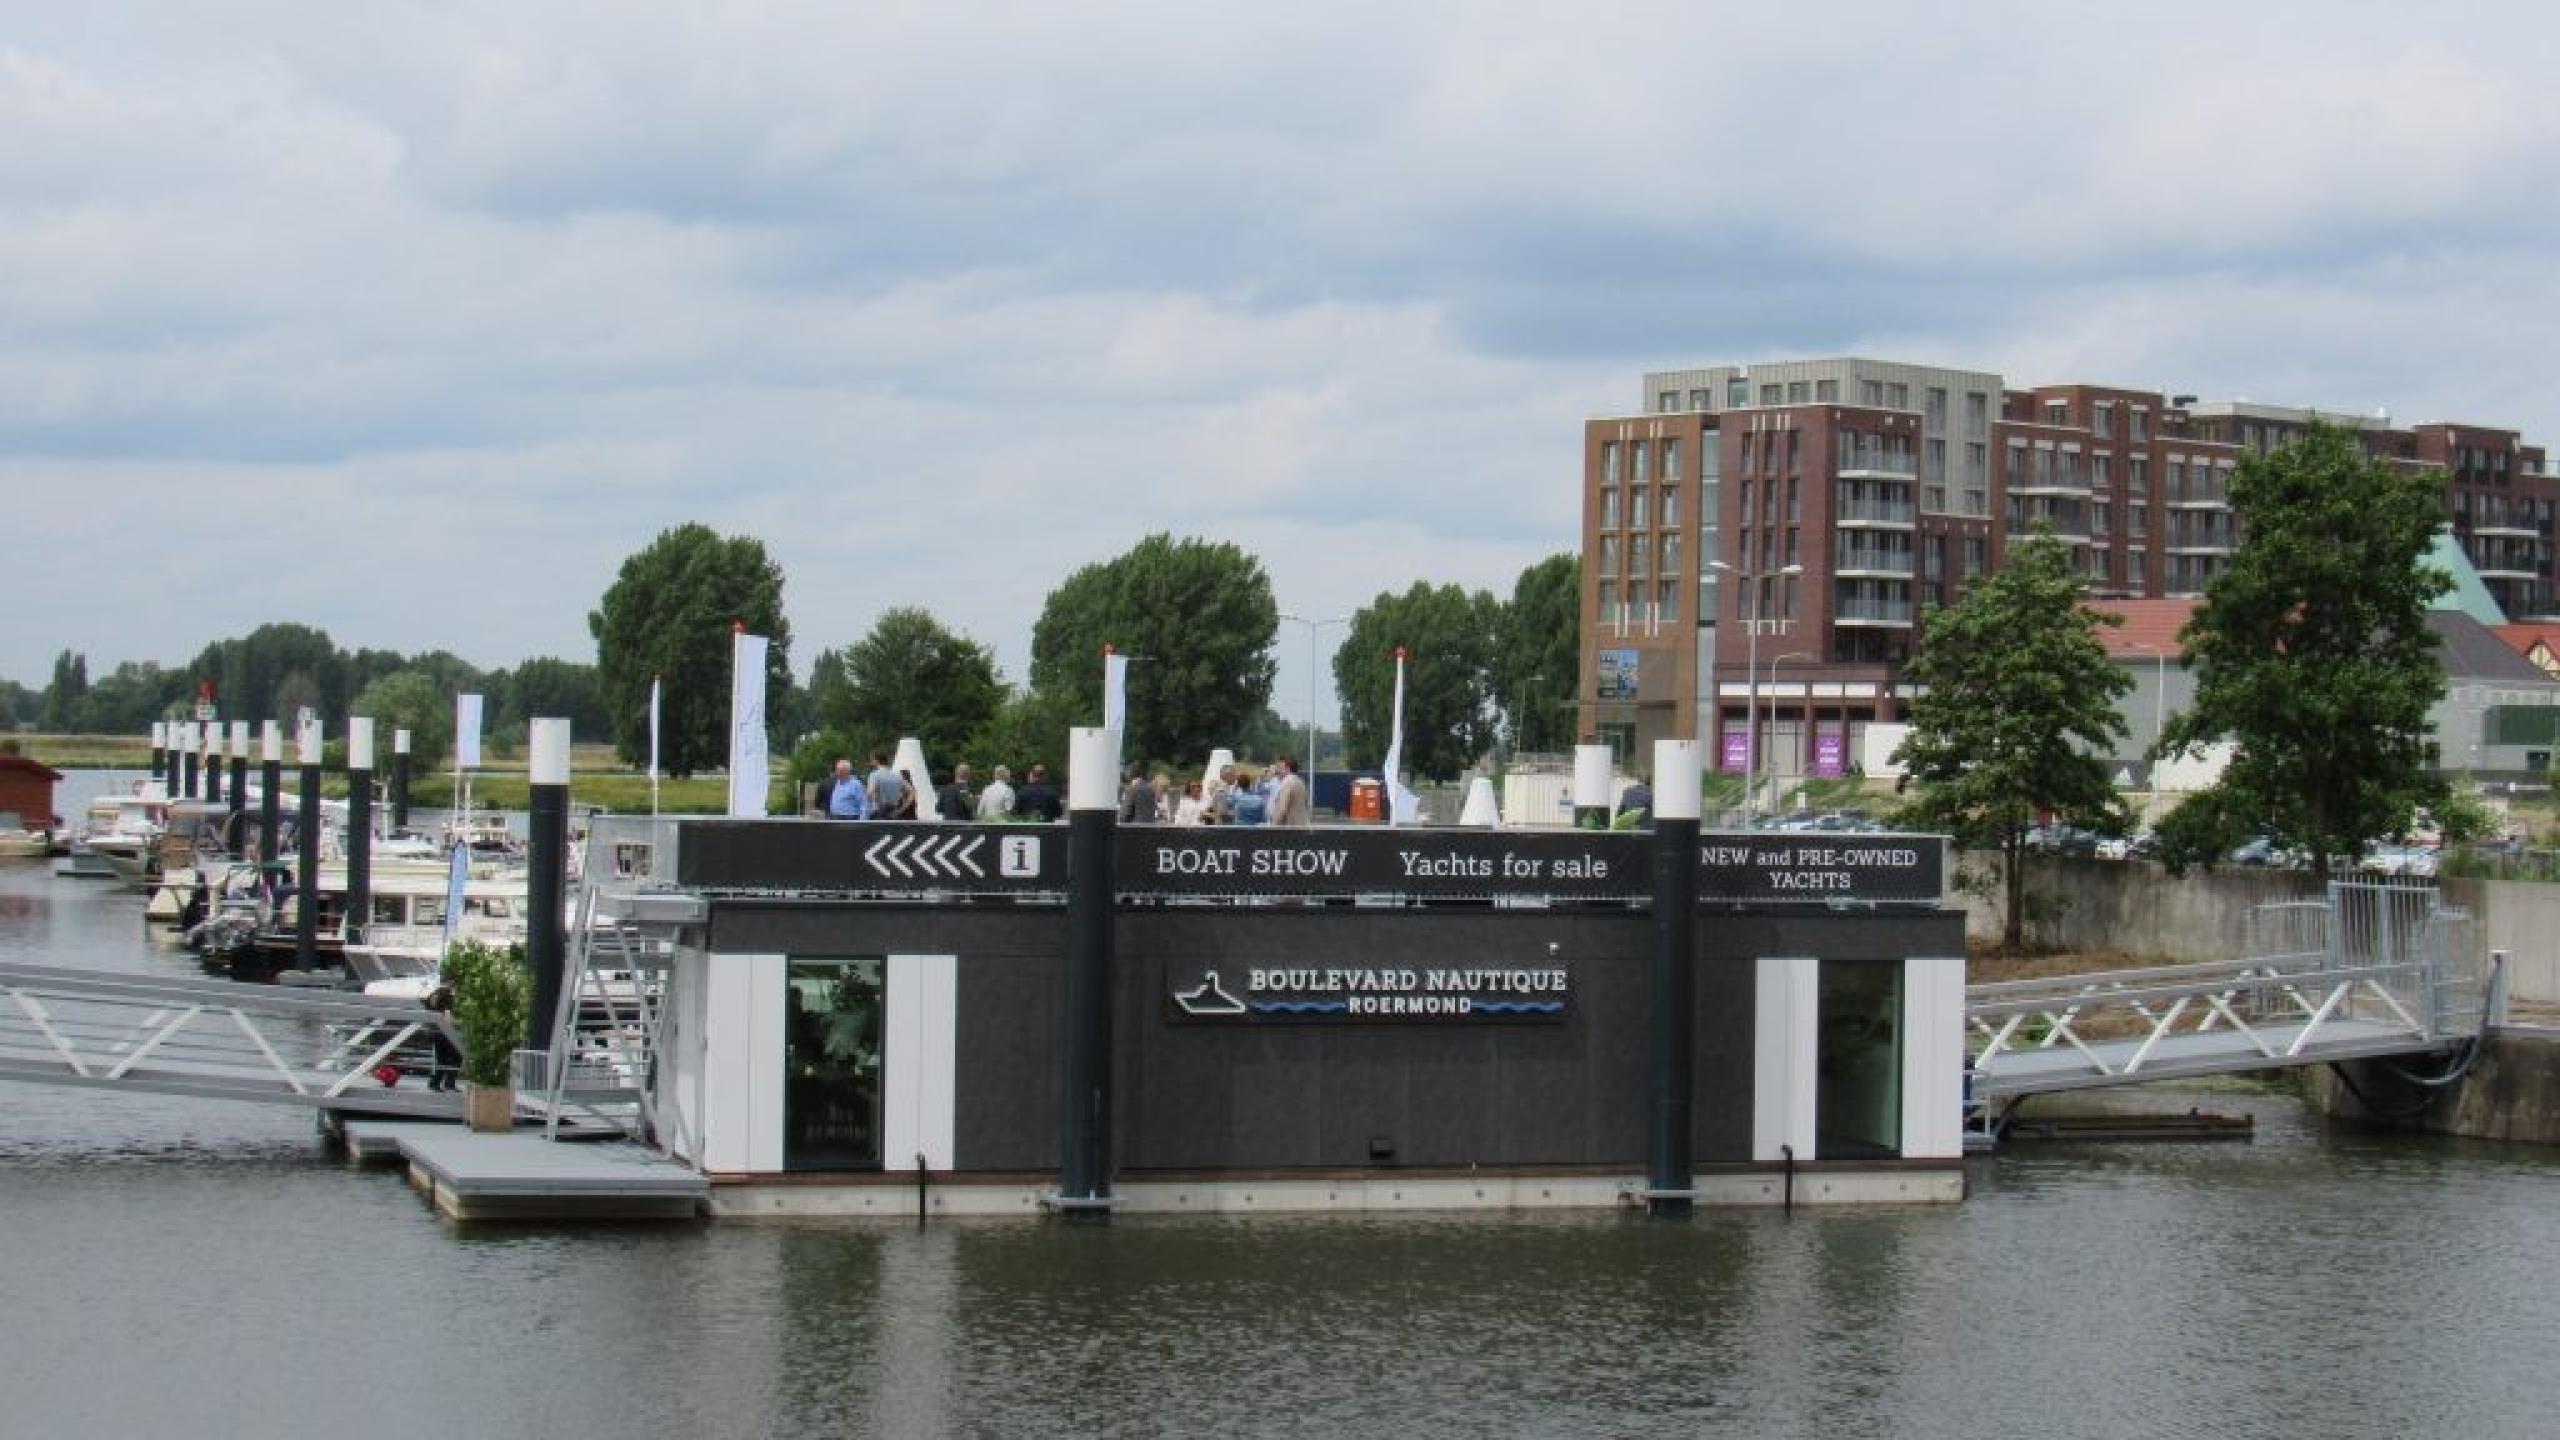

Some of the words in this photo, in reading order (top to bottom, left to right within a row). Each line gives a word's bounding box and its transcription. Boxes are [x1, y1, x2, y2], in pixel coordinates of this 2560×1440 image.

[1157, 848, 1240, 874] BOAT
[1251, 850, 1348, 875] SHOW
[1400, 851, 1493, 876] Yachts
[1502, 853, 1543, 877] for
[1552, 854, 1608, 878] sale
[1701, 847, 1750, 865] NEW
[1757, 850, 1791, 866] and
[1798, 849, 1917, 866] PRE-OWNED
[1769, 871, 1851, 889] YACHTS
[1249, 969, 1417, 991] BOULEVARD
[1425, 969, 1566, 993] NAUTIQUE
[1349, 997, 1471, 1014] ROERMOND
